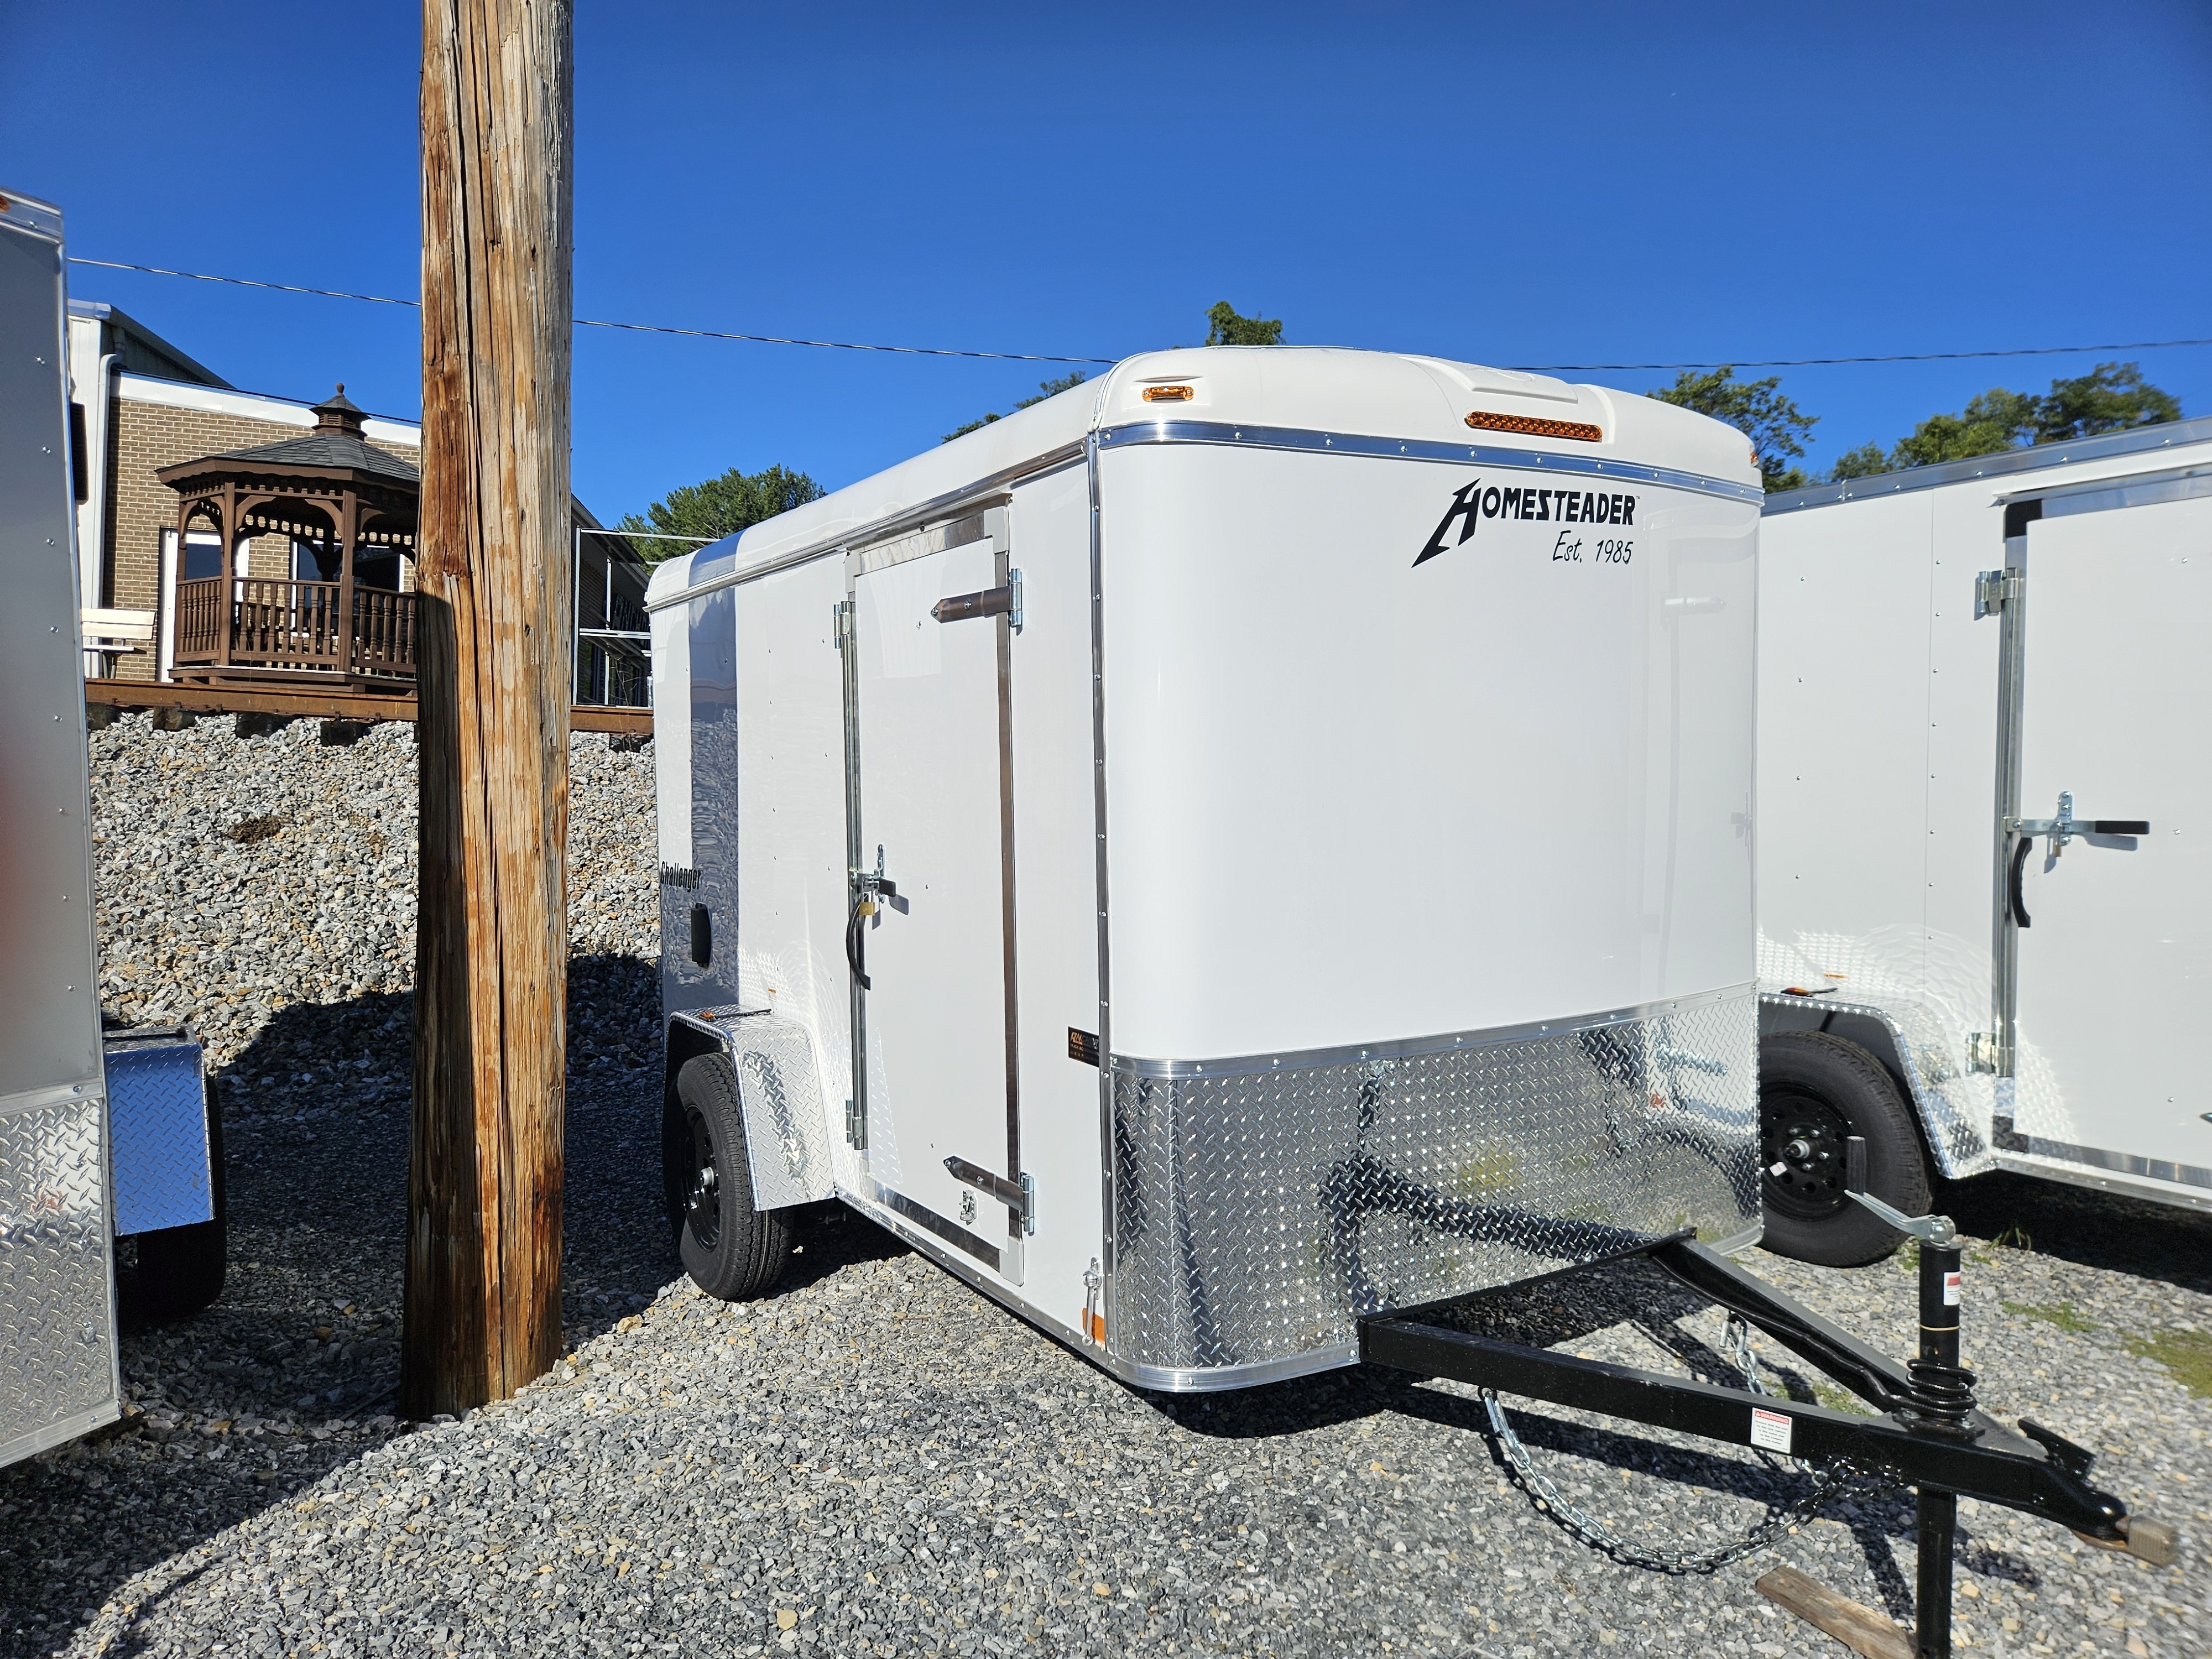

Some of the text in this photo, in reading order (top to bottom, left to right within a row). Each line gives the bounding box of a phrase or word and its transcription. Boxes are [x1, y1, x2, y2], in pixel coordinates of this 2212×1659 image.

[1411, 478, 1635, 568] HOMESTEADER
[1552, 530, 1634, 565] Est. 1985
[661, 860, 703, 893] Challenger
